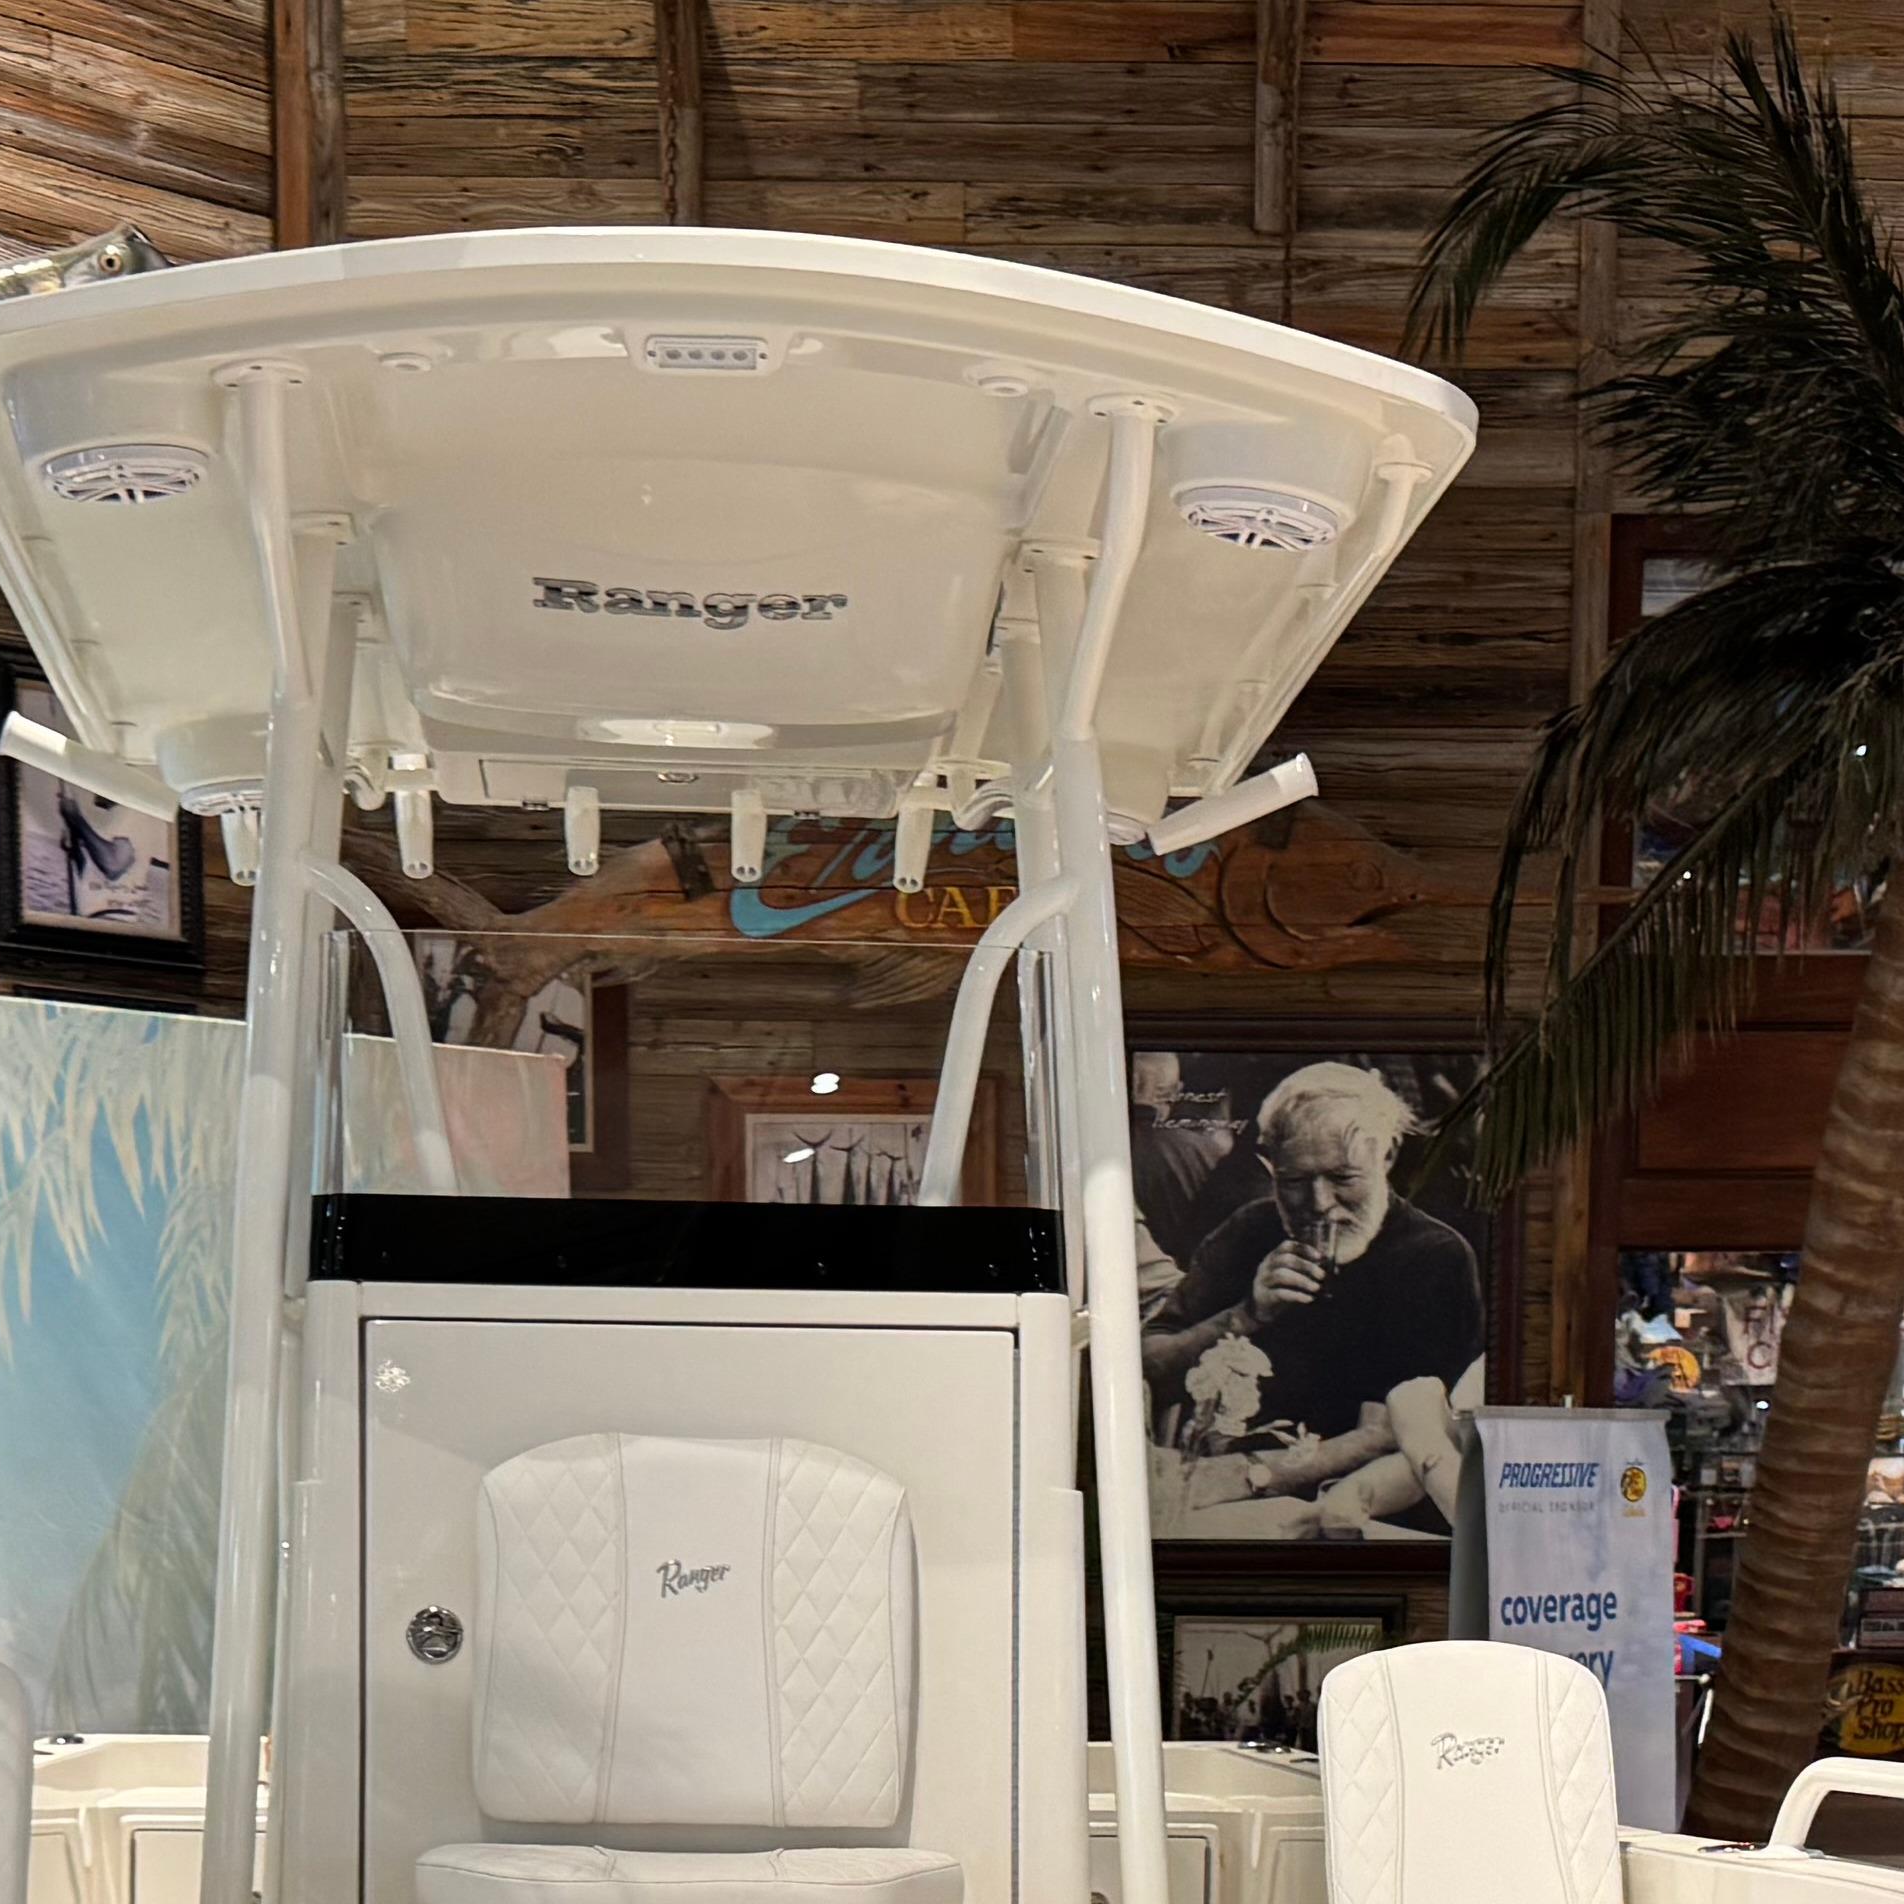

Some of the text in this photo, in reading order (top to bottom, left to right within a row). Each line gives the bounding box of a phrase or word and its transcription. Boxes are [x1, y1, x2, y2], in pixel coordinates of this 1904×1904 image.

[532, 576, 849, 630] Ranger
[1499, 1462, 1600, 1489] PROGRESSIVE
[655, 1558, 731, 1599] Ranger
[1500, 1591, 1618, 1632] coverage
